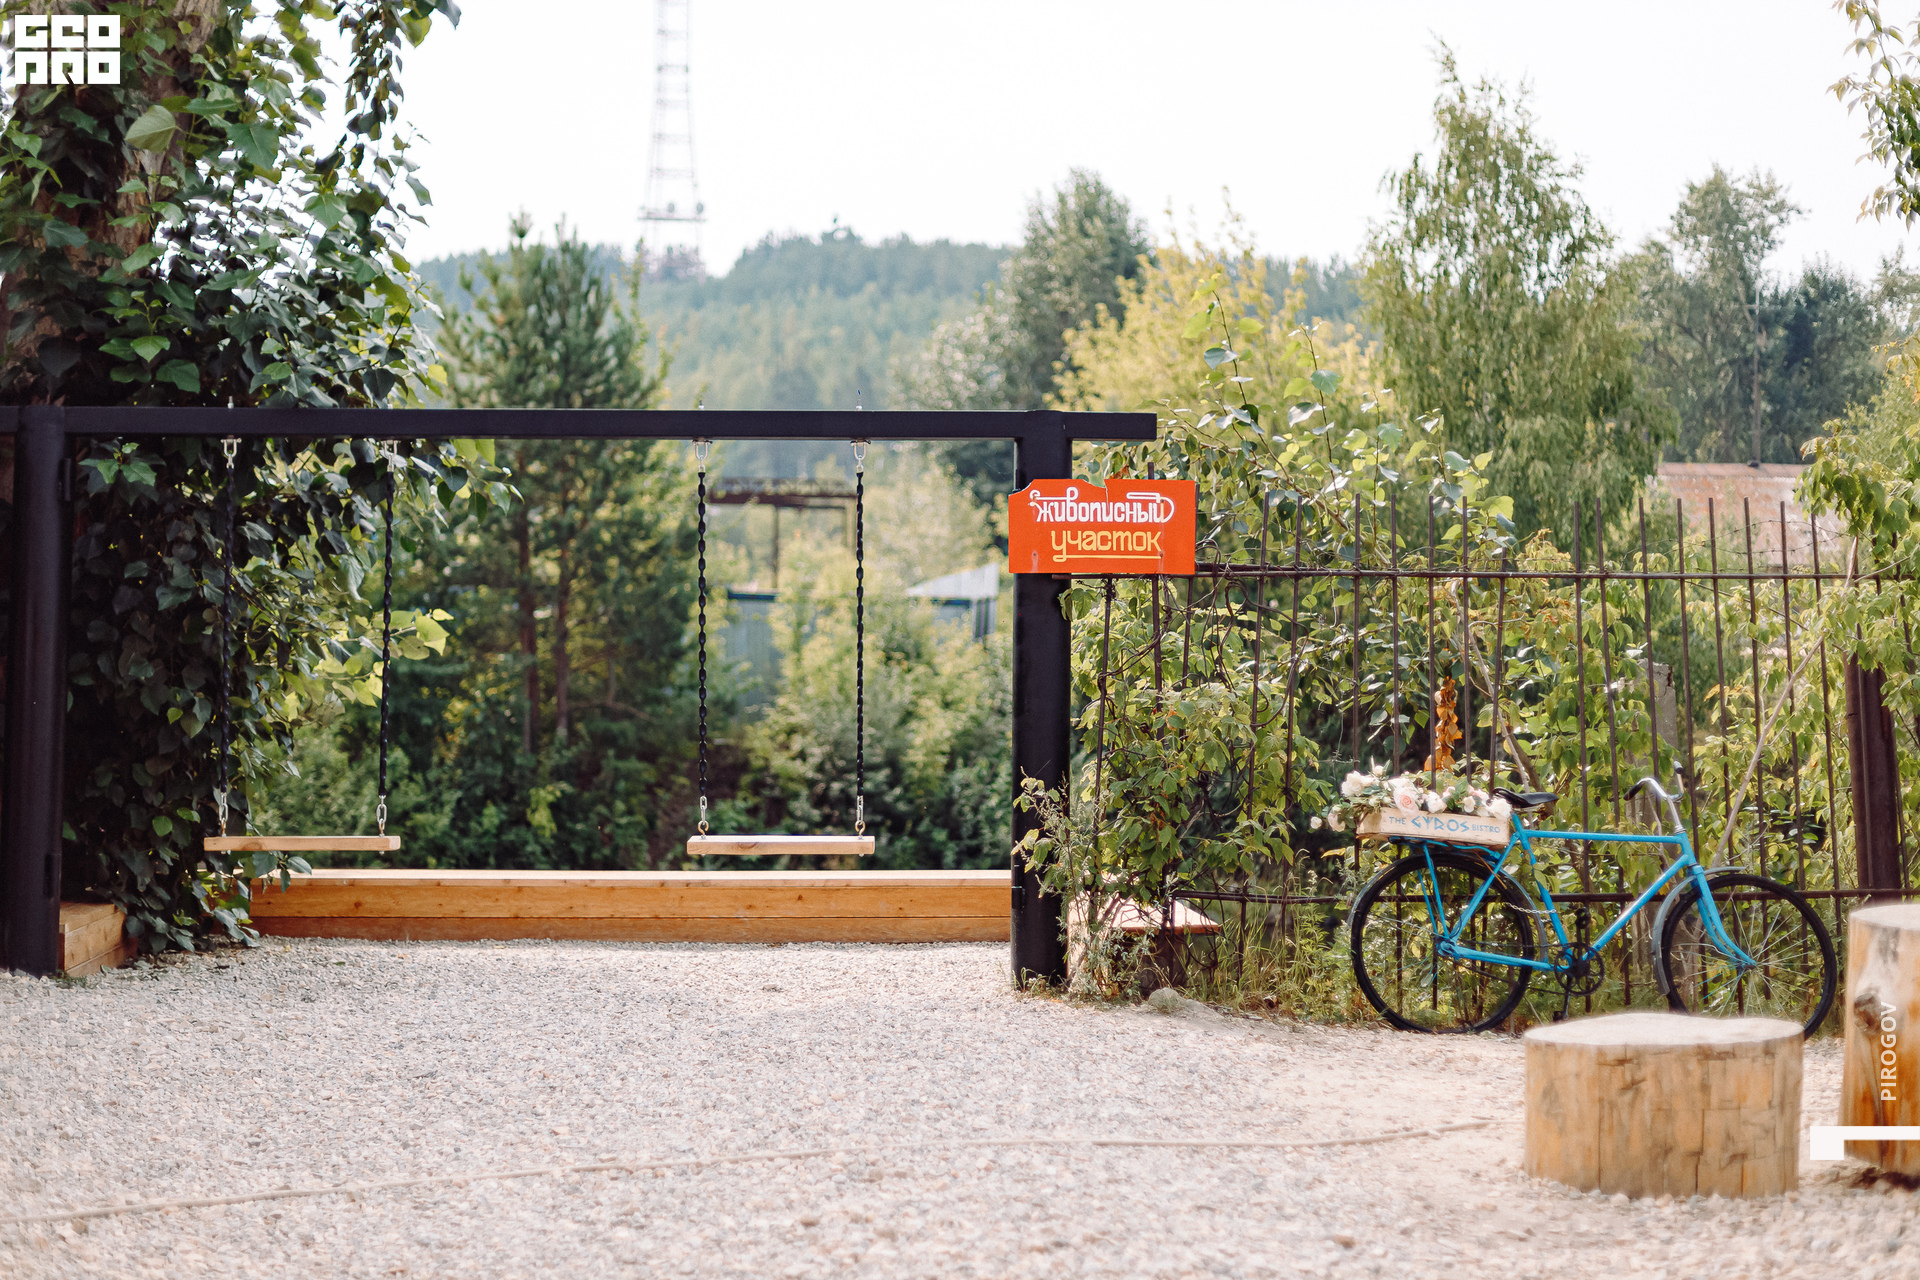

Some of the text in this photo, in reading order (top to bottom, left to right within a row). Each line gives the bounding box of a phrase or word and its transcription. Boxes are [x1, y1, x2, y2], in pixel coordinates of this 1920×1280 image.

[1051, 530, 1162, 562] участок
[1389, 815, 1501, 834] THE GYROS BISTRO
